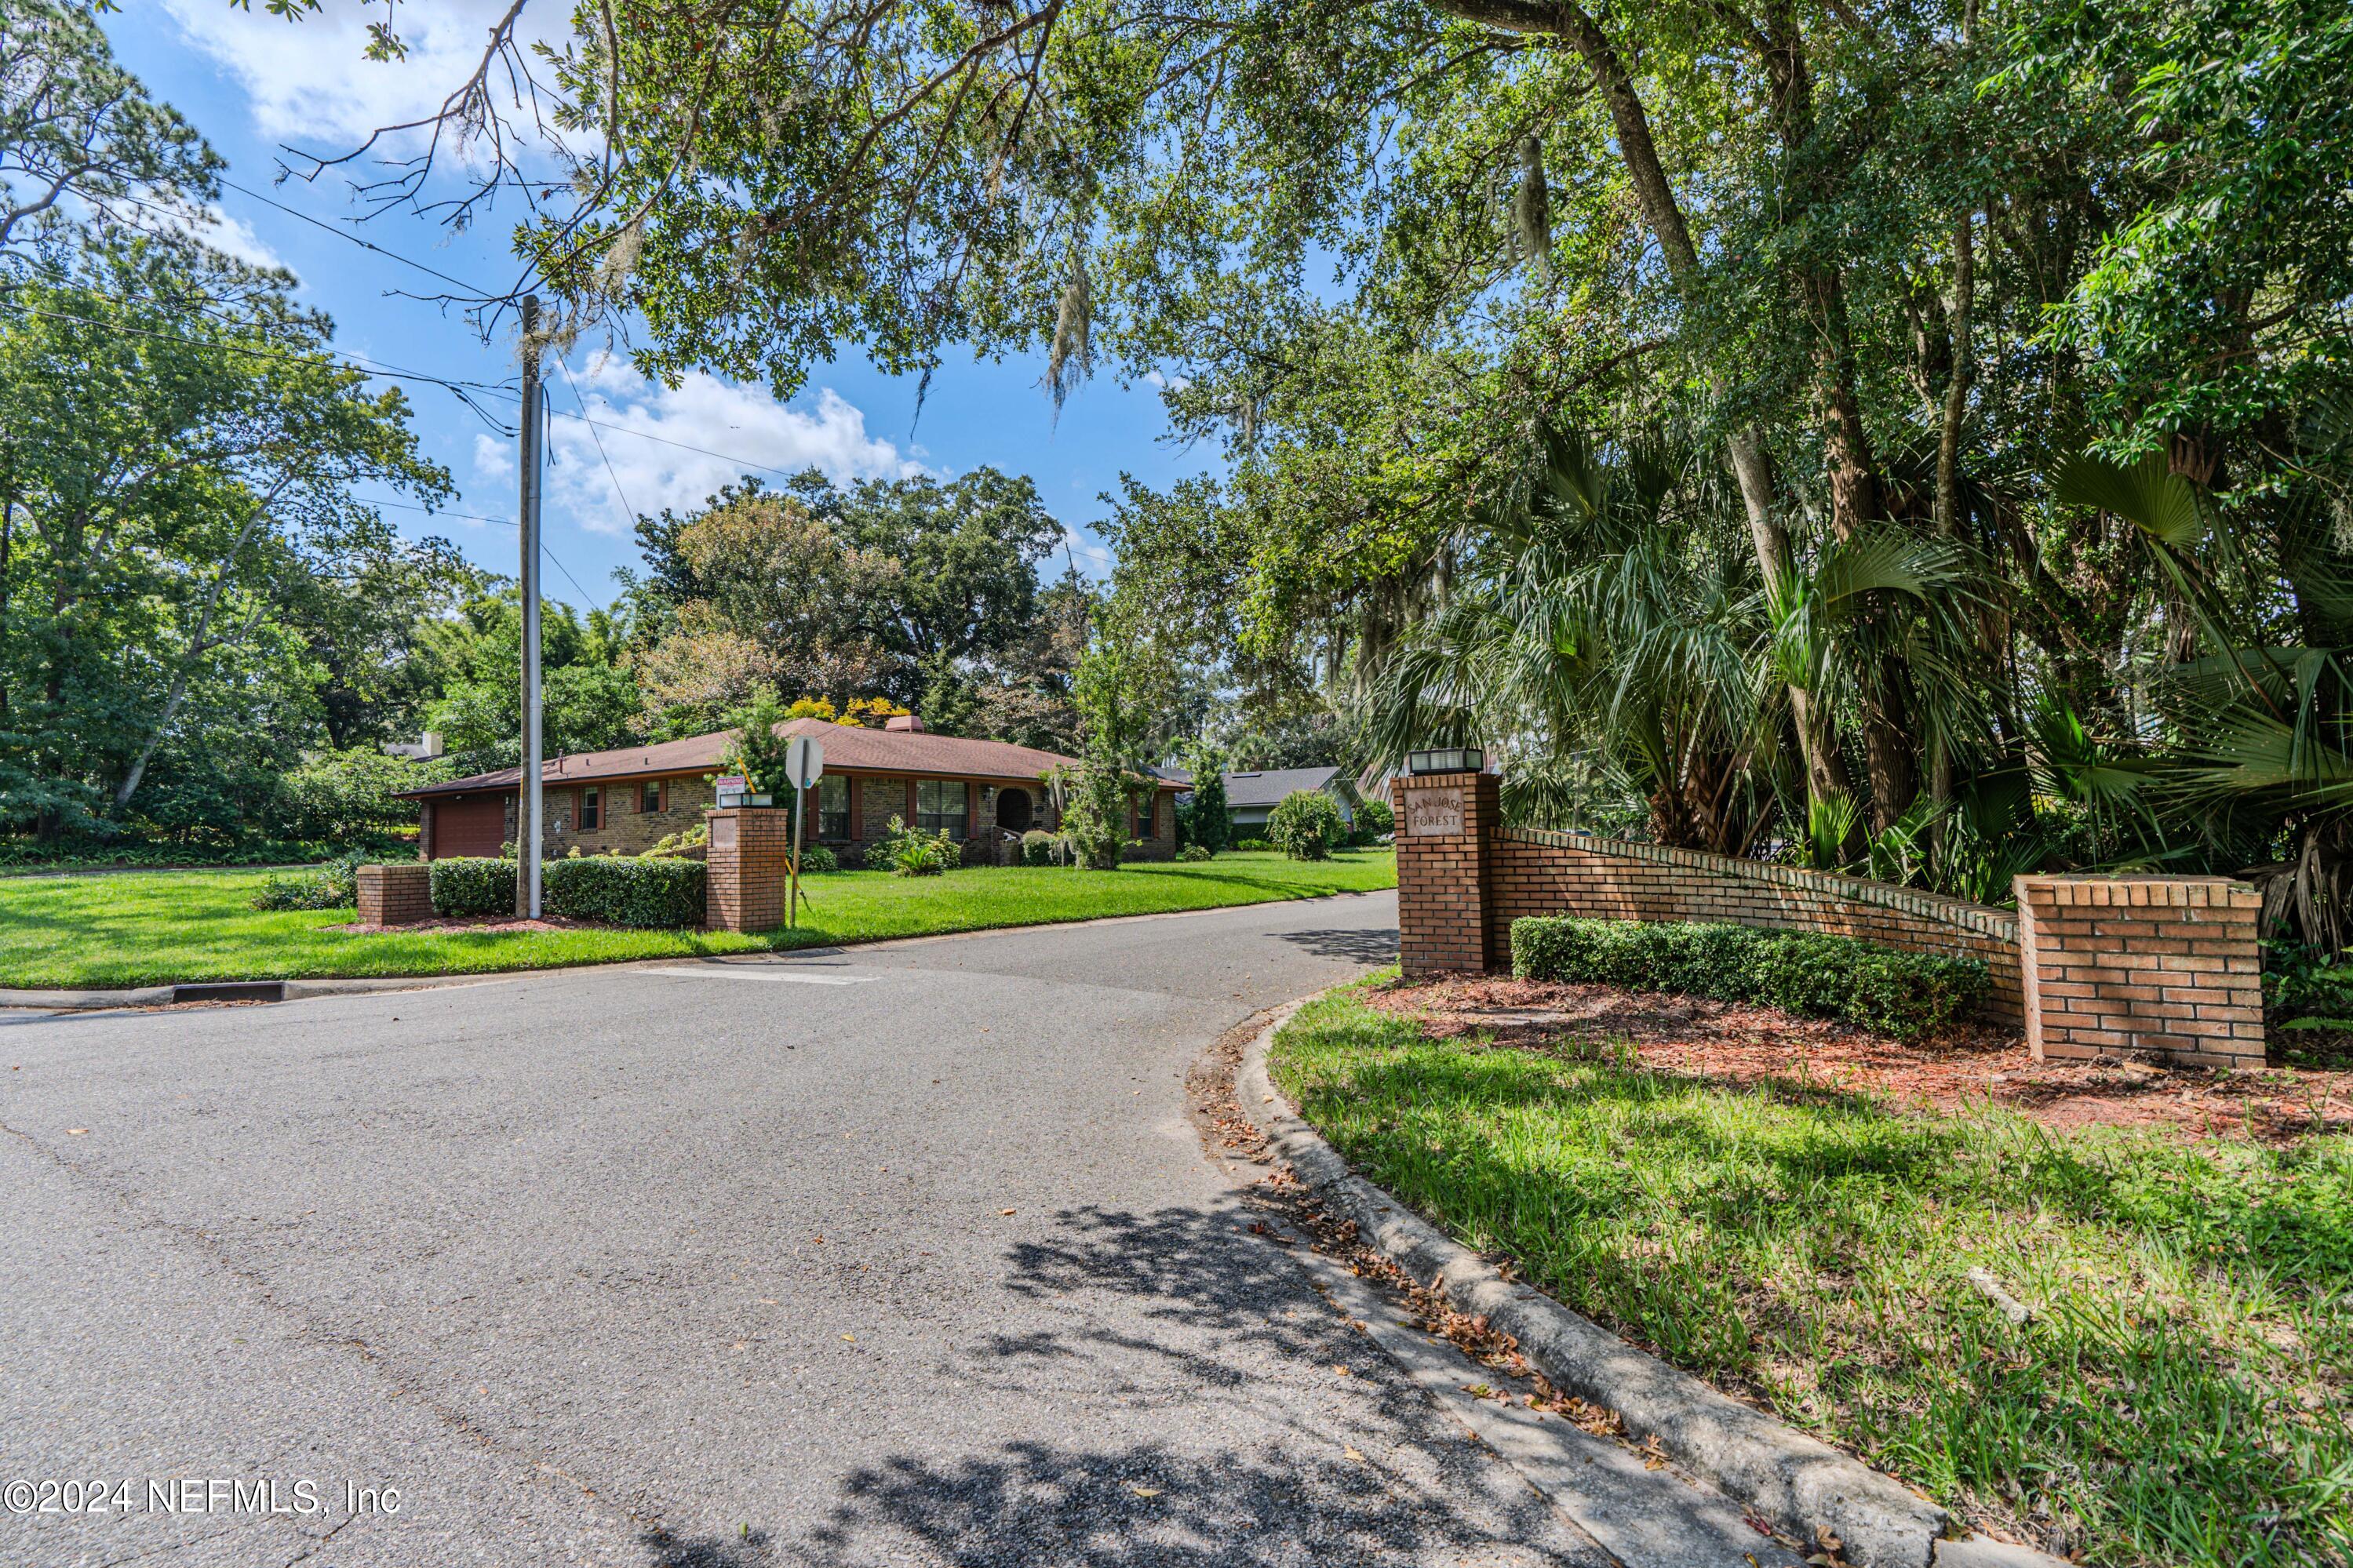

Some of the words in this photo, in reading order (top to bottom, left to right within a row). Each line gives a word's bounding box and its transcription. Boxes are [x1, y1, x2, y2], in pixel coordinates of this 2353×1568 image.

[1408, 797, 1432, 815] SAN
[1434, 796, 1462, 813] JOSE
[1414, 815, 1458, 827] FOREST
